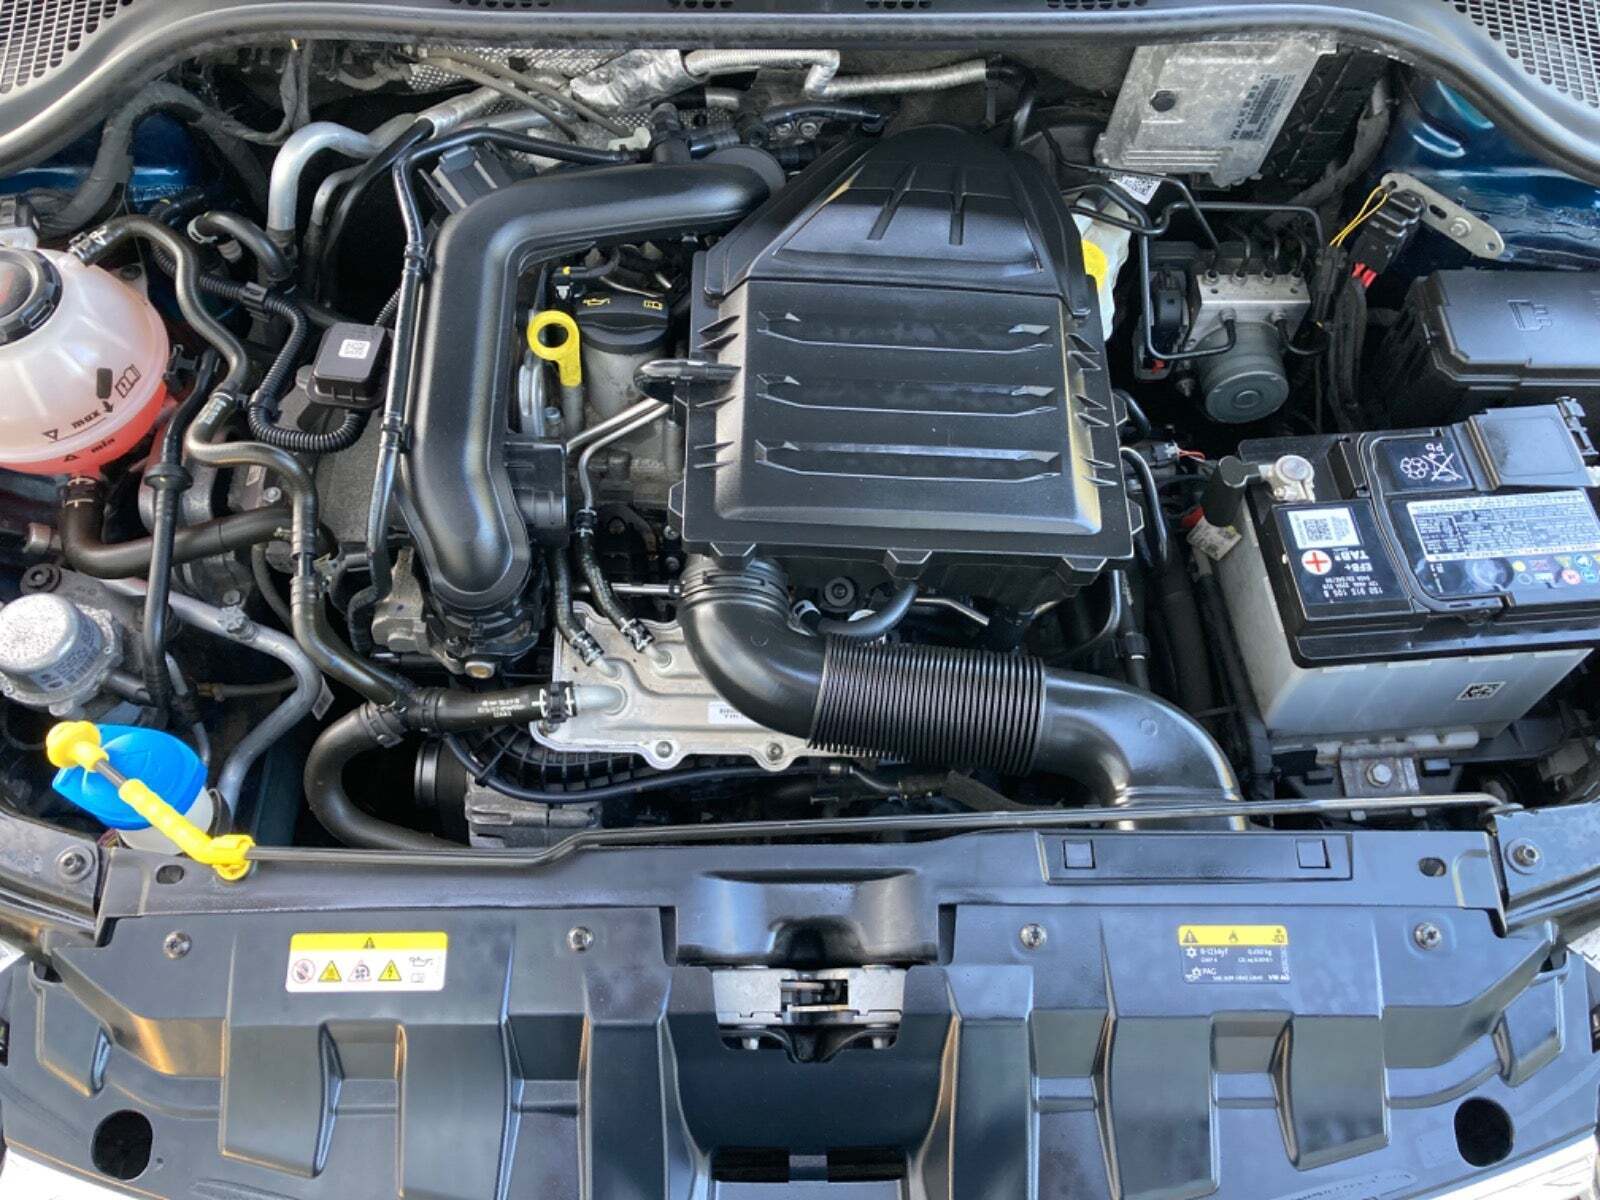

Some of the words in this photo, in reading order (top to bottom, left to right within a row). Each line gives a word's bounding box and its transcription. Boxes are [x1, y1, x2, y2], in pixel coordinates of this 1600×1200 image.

[71, 410, 100, 428] max
[91, 438, 116, 453] min
[1425, 442, 1444, 452] Pb
[1202, 967, 1217, 975] PAG
